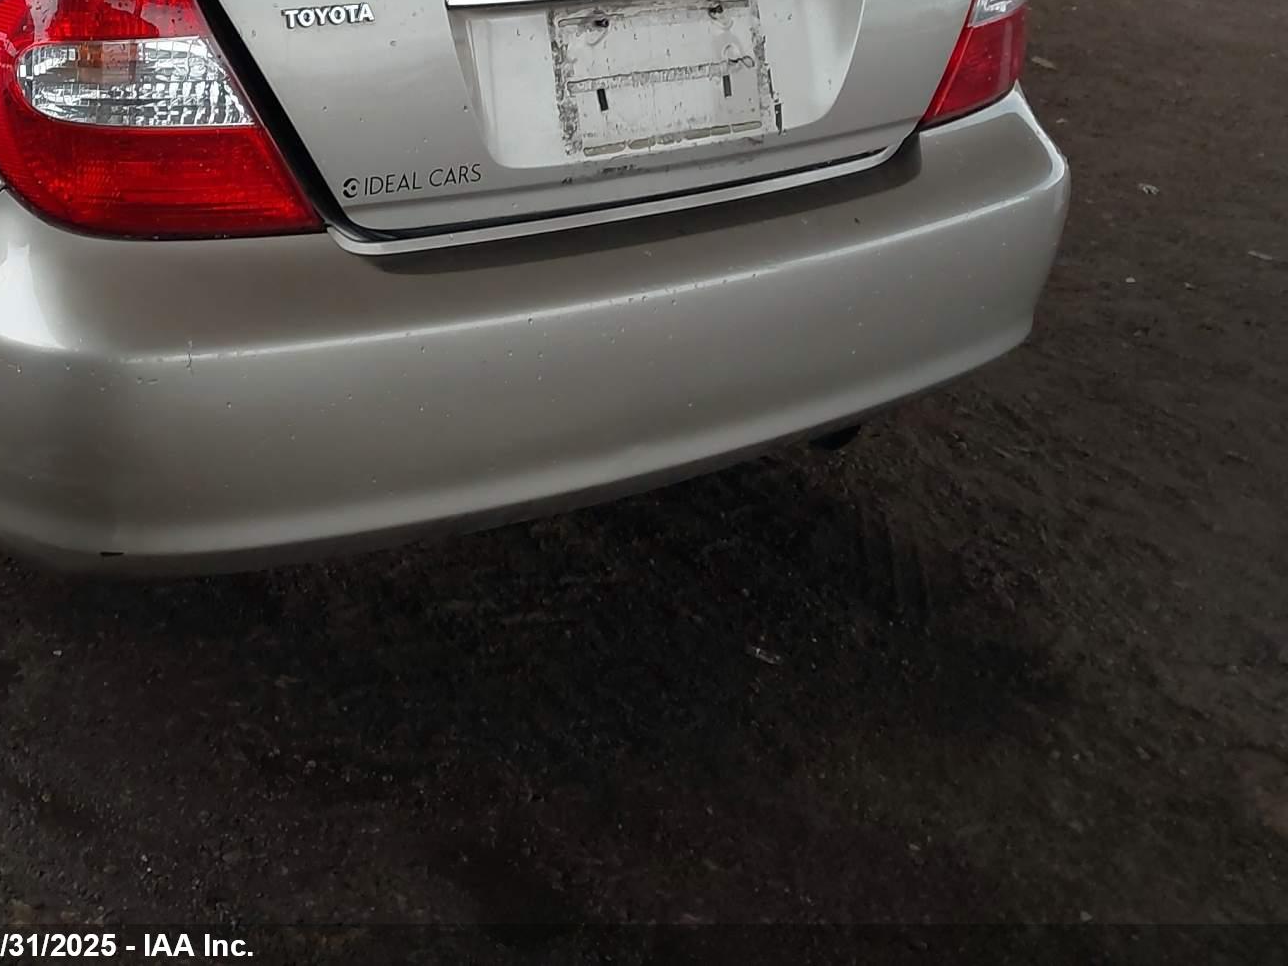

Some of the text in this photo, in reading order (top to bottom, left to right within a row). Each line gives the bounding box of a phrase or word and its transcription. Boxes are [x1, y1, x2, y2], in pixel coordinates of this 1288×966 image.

[281, 2, 375, 29] TOYOTA
[364, 163, 482, 196] IDEAL CARS
